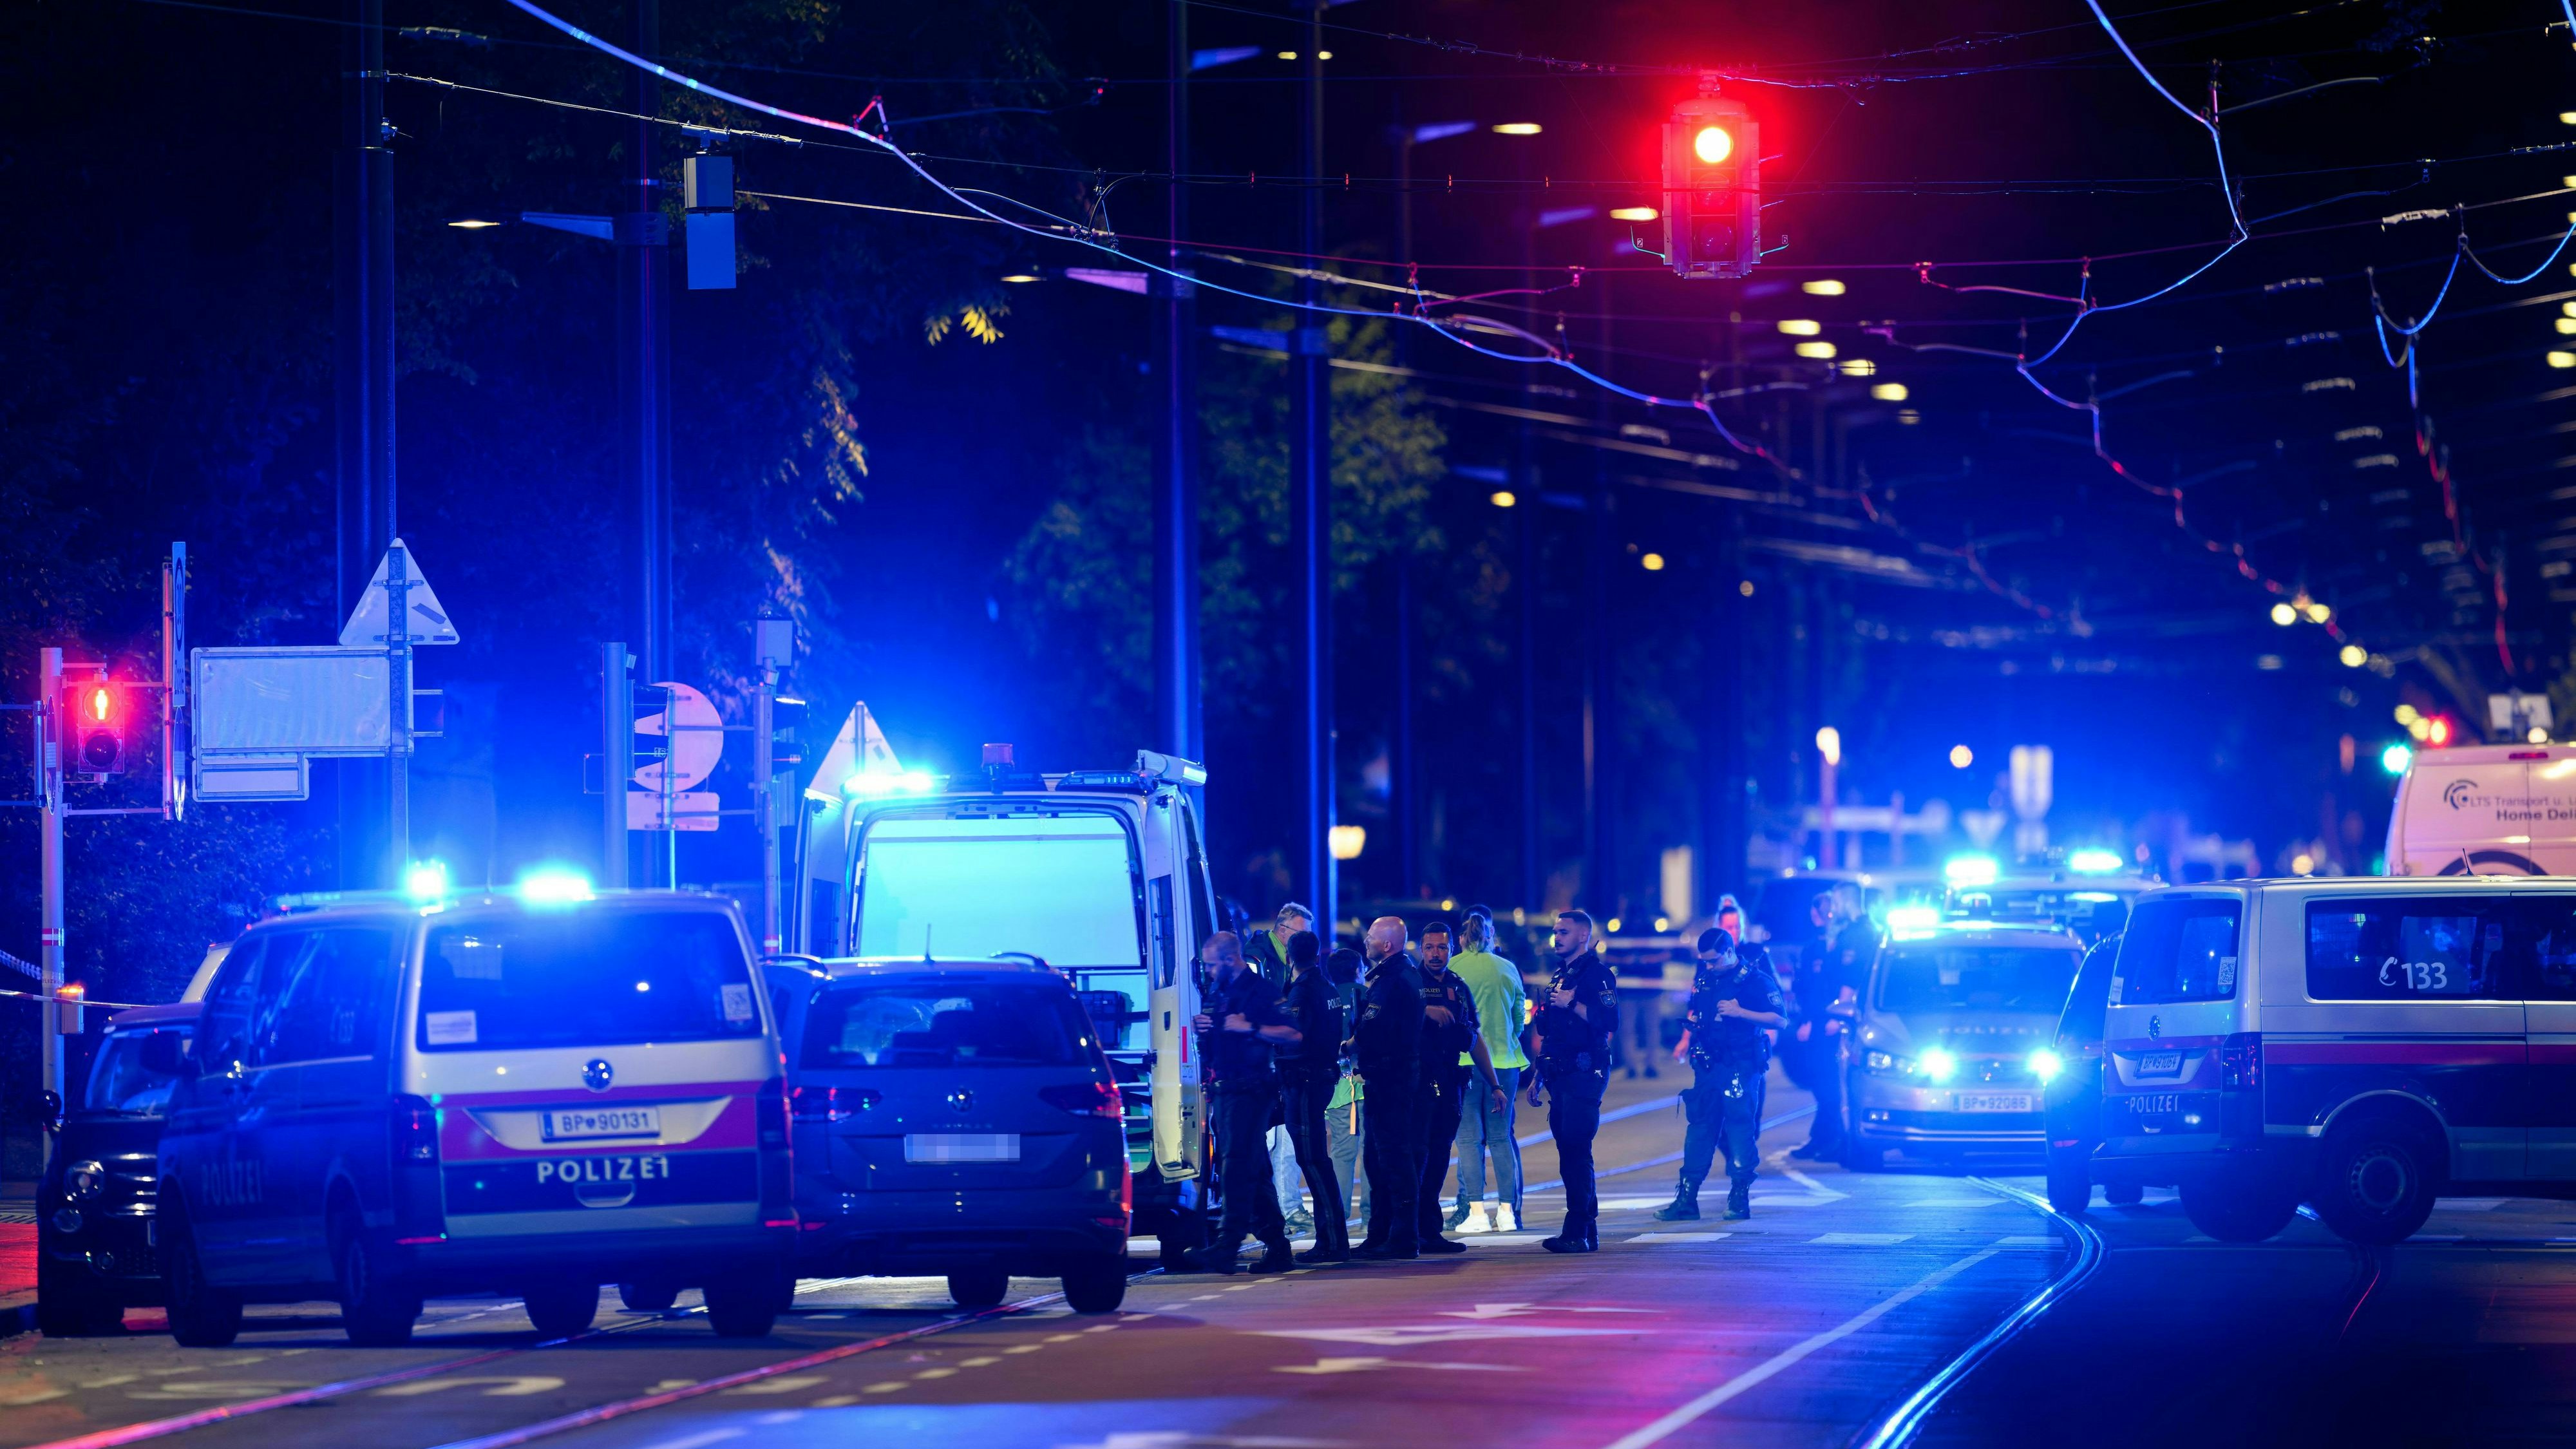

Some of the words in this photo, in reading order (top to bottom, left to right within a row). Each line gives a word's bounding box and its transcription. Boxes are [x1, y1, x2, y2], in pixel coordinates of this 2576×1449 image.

[1637, 238, 1643, 247] 2
[1782, 235, 1788, 244] 6
[2470, 797, 2490, 806] LTS
[2495, 796, 2548, 806] Transport
[2496, 810, 2543, 820] Home
[2401, 962, 2447, 989] 133
[2129, 1095, 2179, 1113] POLIZEI
[562, 1115, 583, 1132] BP
[597, 1112, 649, 1130] 90131
[537, 1156, 668, 1184] POLIZEI
[201, 1160, 263, 1206] POLIZEI
